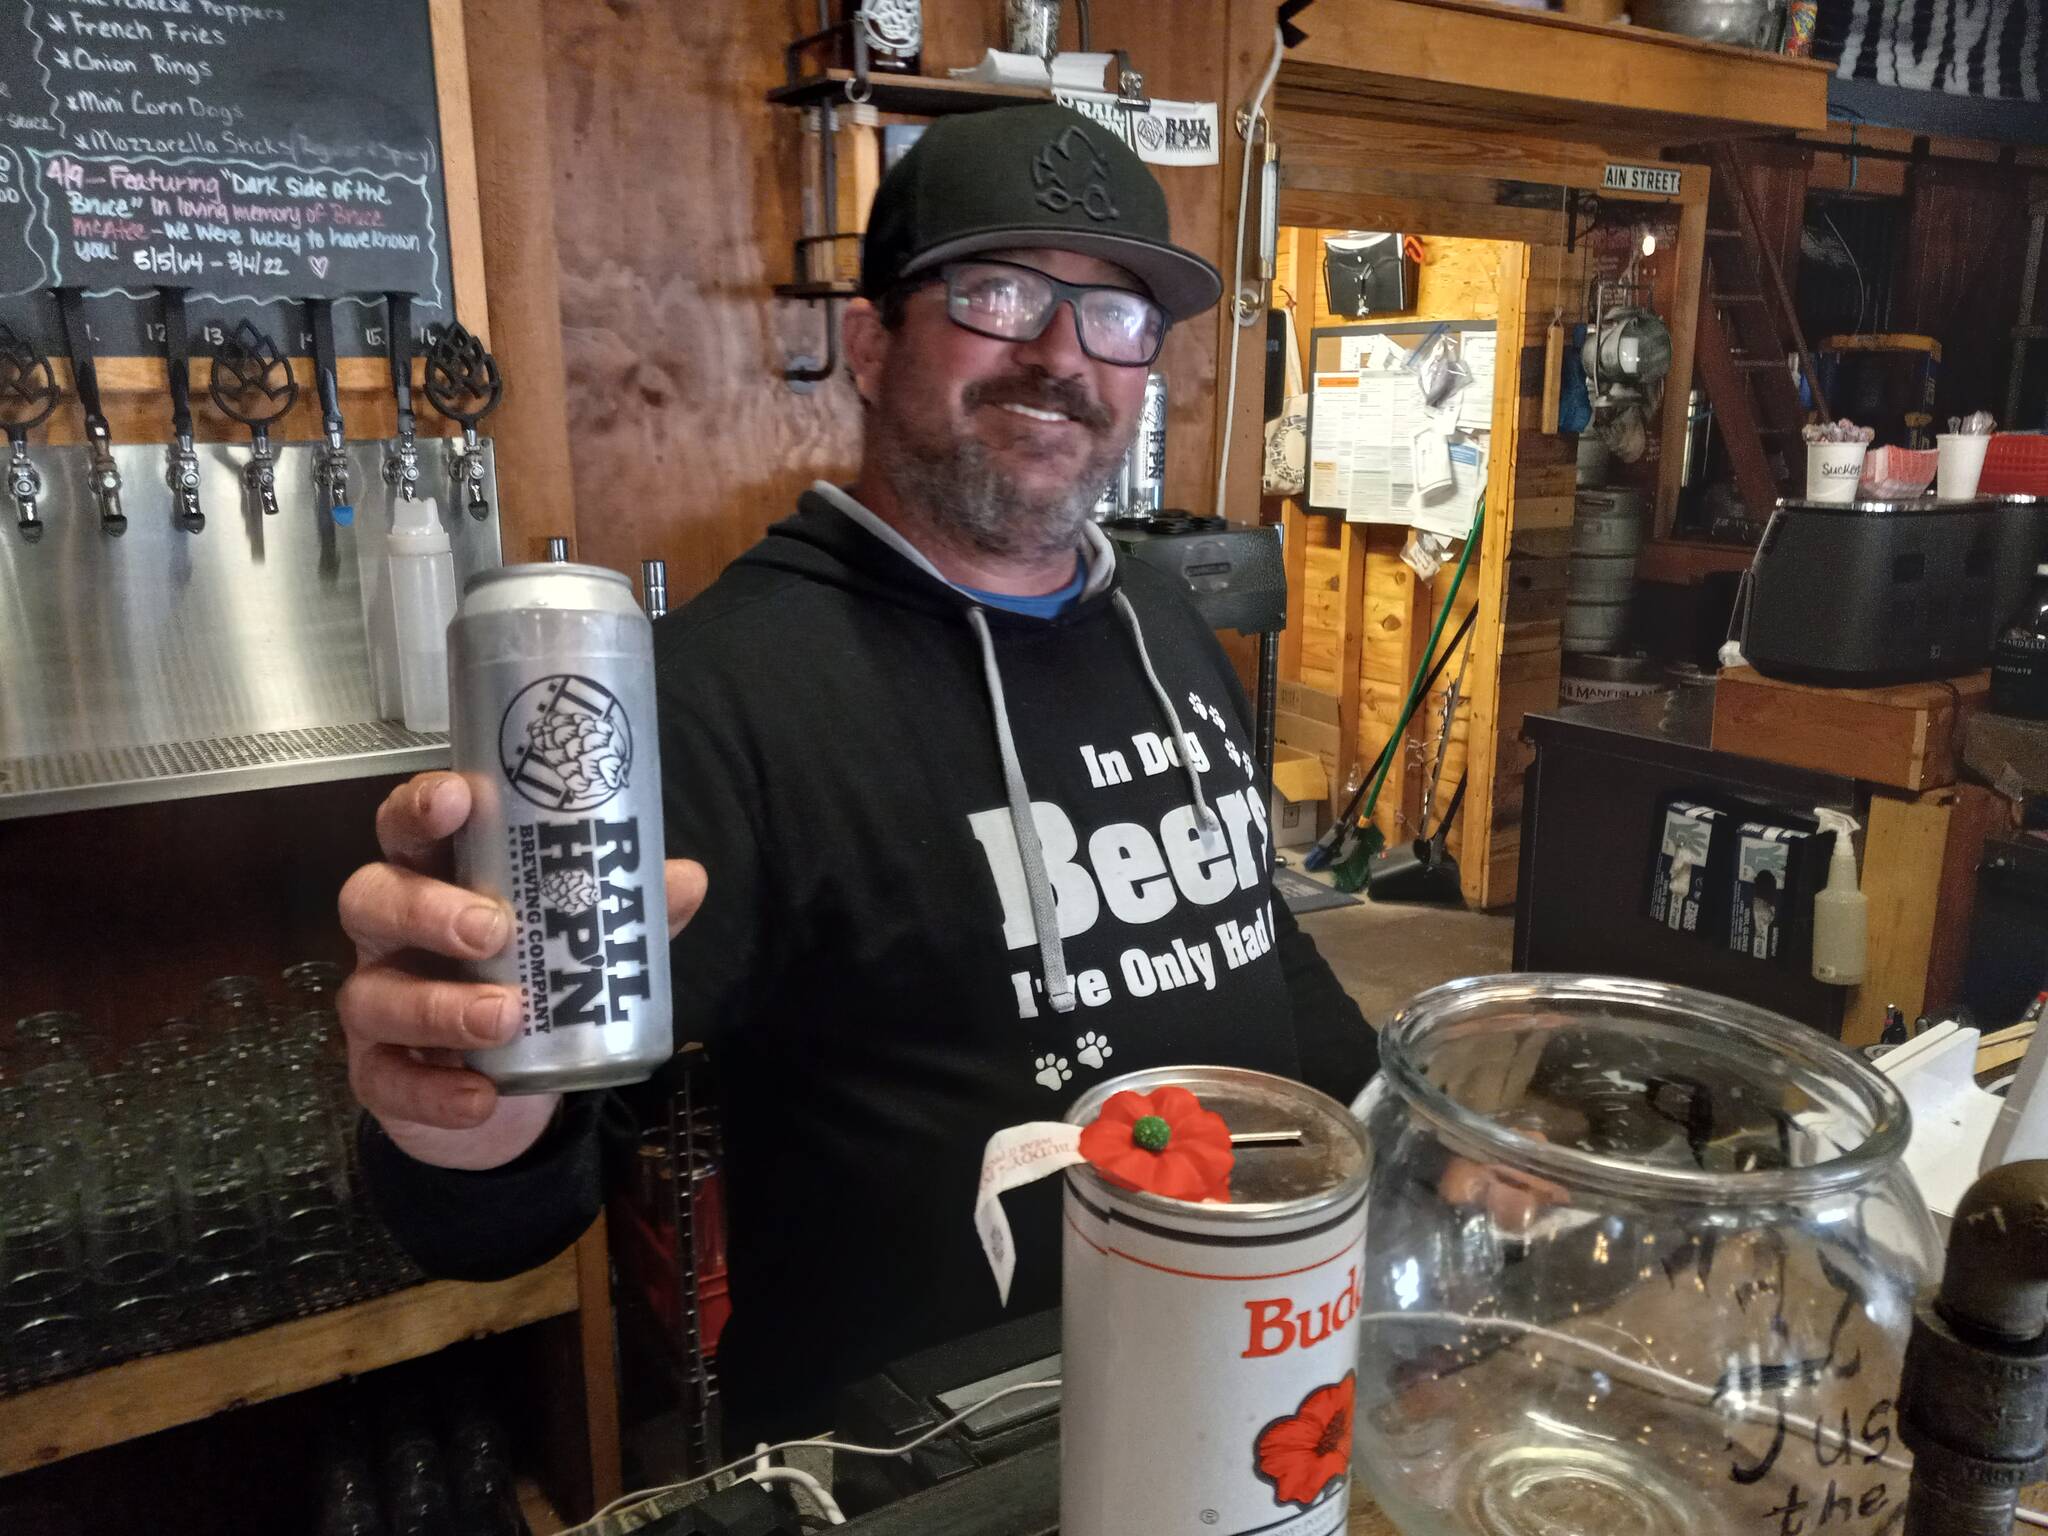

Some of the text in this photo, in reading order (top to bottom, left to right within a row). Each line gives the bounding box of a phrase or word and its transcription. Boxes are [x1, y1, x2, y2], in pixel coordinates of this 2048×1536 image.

[68, 11, 226, 45] French Fries
[73, 46, 213, 85] Onion Rings
[77, 90, 244, 126] Mini Corn Dogs
[89, 129, 218, 153] Mozzarella
[109, 165, 221, 204] Featuring
[332, 178, 354, 201] of
[354, 180, 393, 206] the
[1631, 170, 1677, 192] STREET
[177, 195, 230, 225] loving
[232, 203, 302, 230] memory
[305, 202, 327, 224] of
[249, 226, 301, 256] lucky
[305, 227, 326, 250] to
[226, 249, 290, 277] 3/4/22
[203, 325, 225, 346] 13
[1079, 743, 1133, 789] In
[518, 823, 541, 925] BREWING
[594, 816, 651, 1023] RAIL
[1119, 937, 1218, 998] Only
[1215, 907, 1272, 970] Had
[515, 910, 533, 1038] WASHINGTON
[526, 929, 552, 1035] COMPANY
[1763, 1479, 1890, 1536] the
